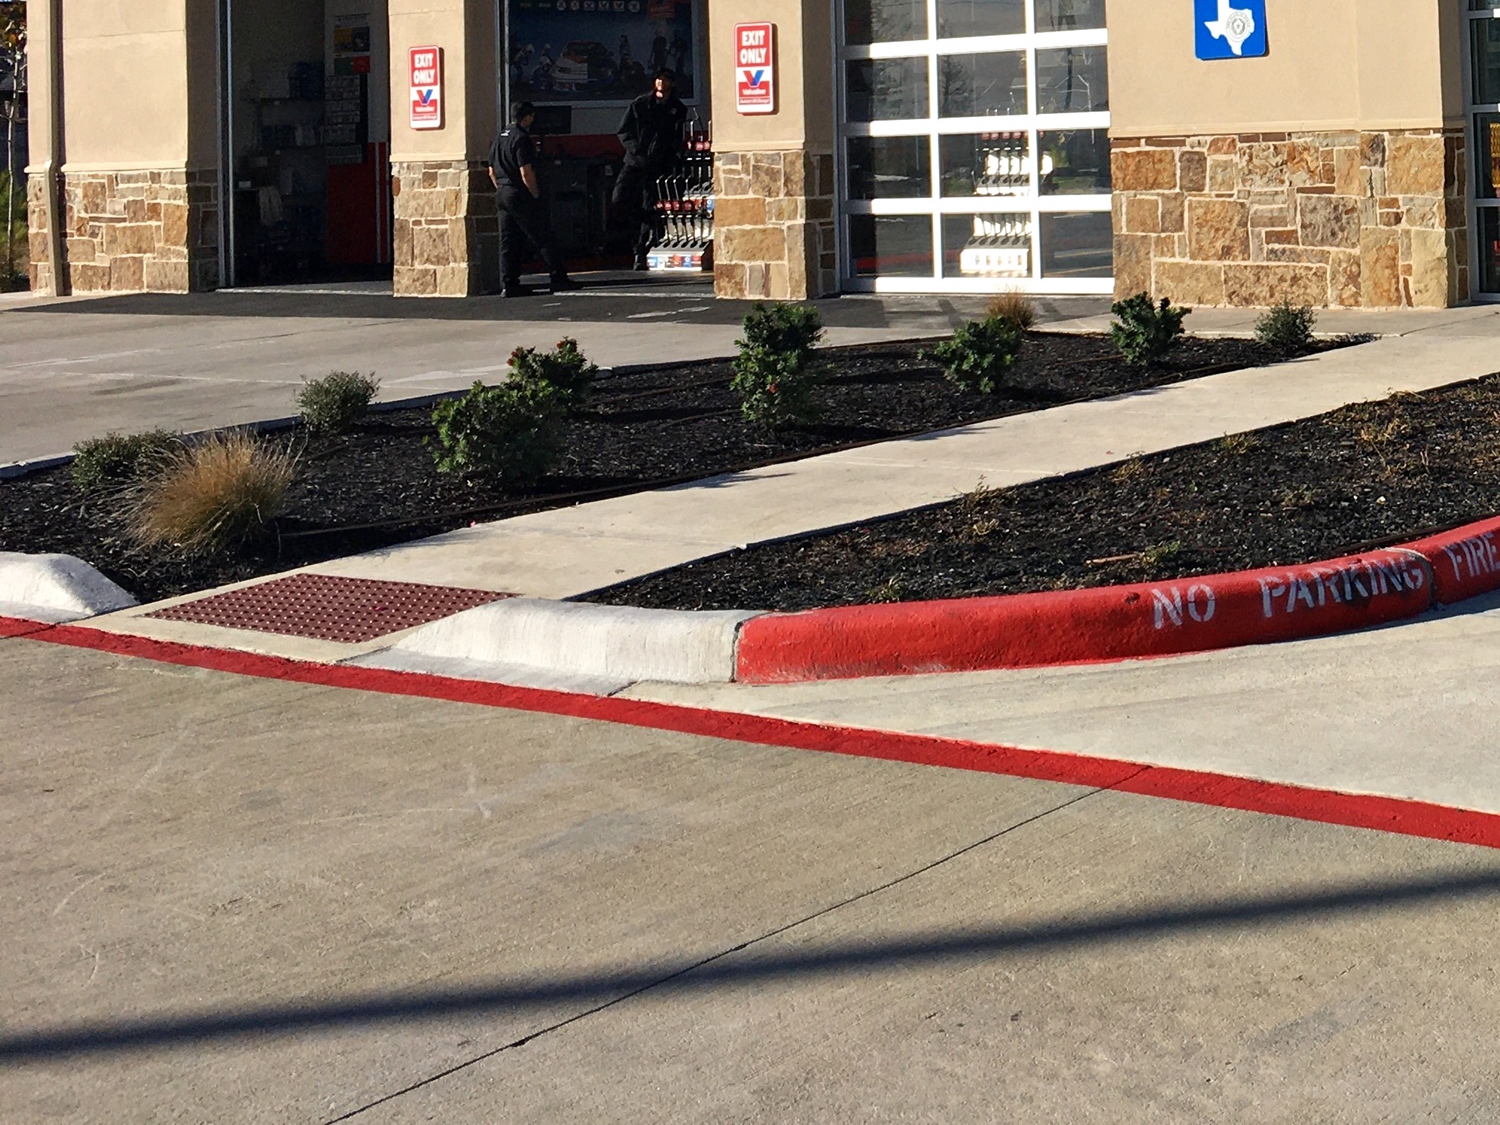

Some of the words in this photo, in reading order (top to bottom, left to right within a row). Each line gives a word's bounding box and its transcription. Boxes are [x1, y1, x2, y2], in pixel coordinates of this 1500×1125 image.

[741, 30, 765, 46] EXIT
[414, 53, 433, 68] EXIT
[740, 47, 766, 64] ONLY
[413, 69, 435, 84] ONLY
[1152, 583, 1216, 629] NO
[1256, 554, 1425, 618] PARKING
